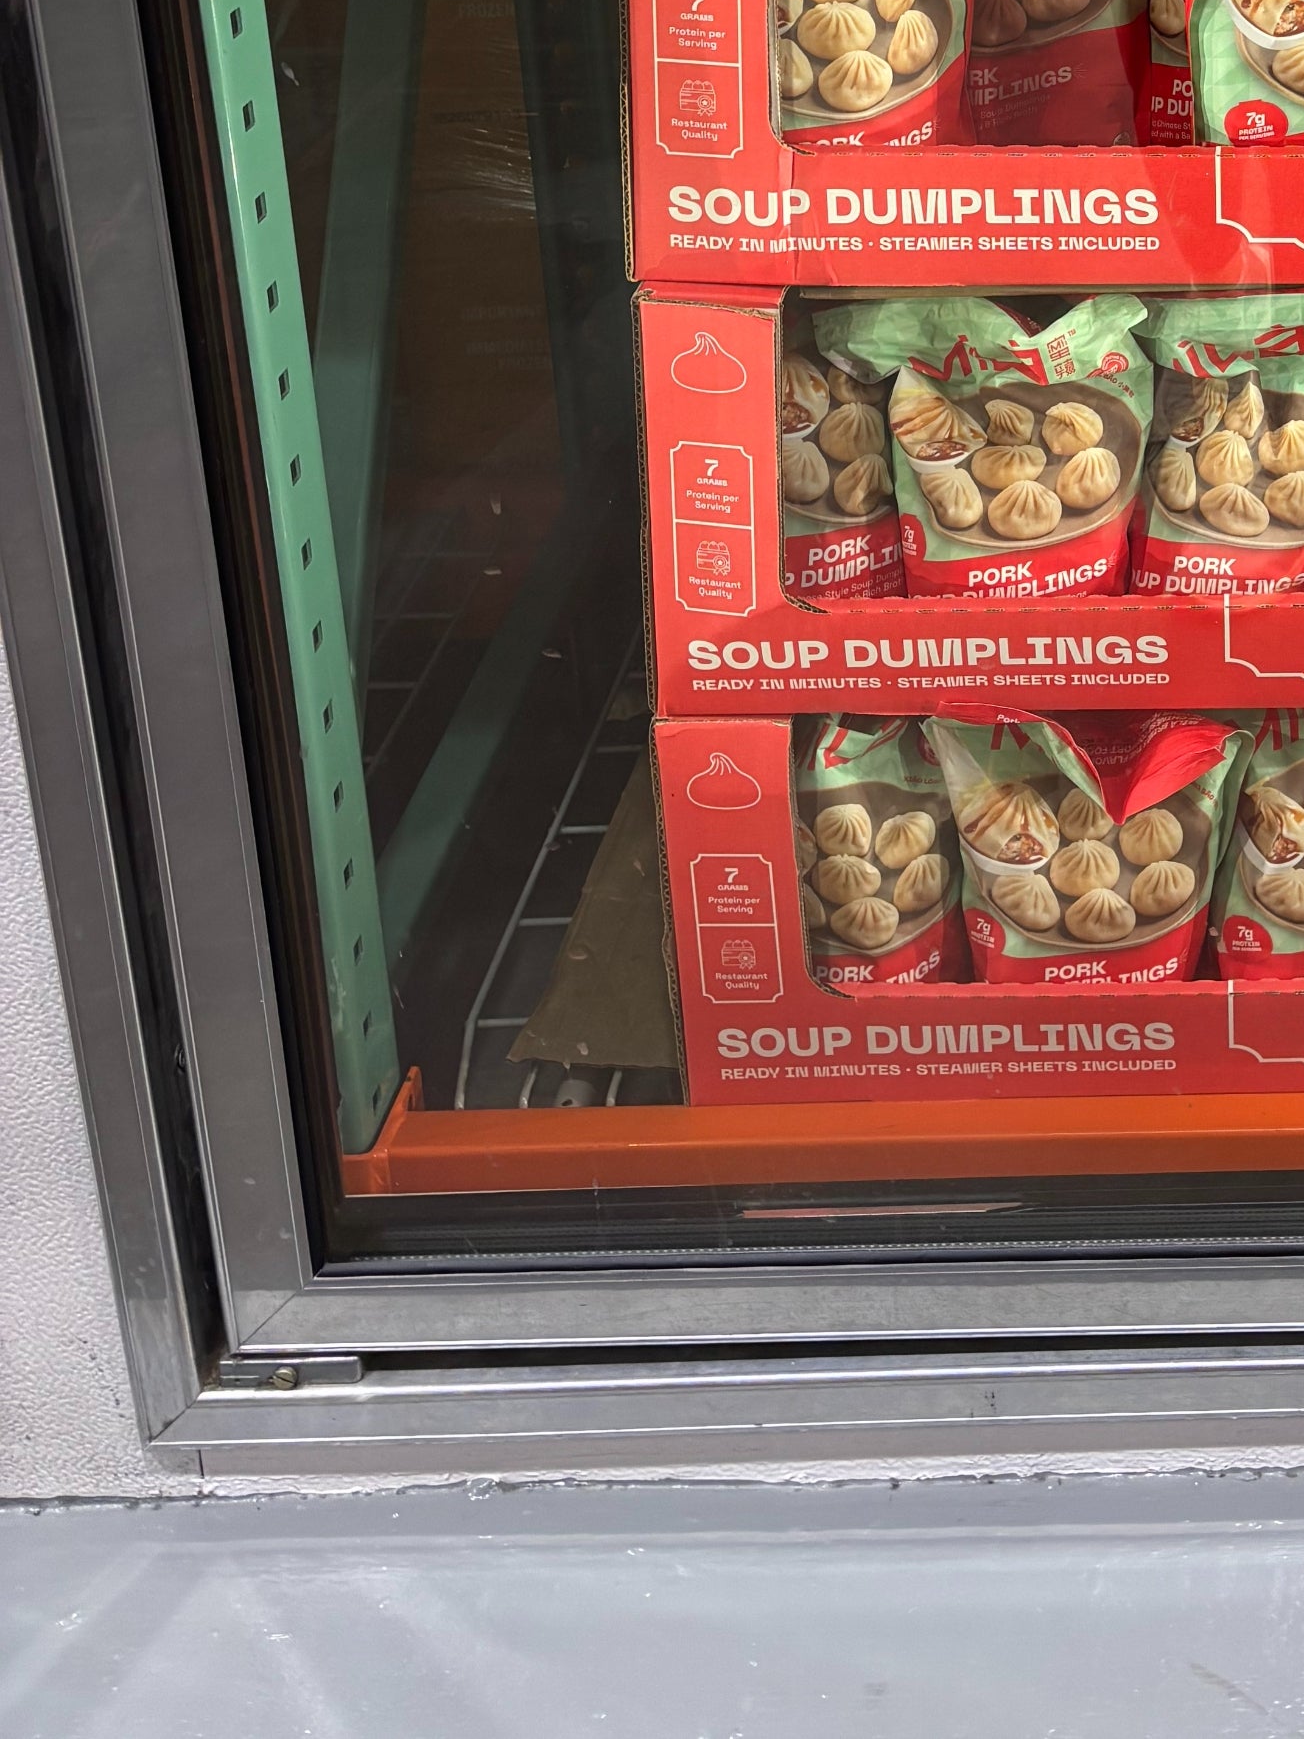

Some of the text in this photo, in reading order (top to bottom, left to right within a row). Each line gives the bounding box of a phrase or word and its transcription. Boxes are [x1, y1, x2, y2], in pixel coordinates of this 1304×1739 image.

[680, 13, 713, 21] GRAMS
[669, 27, 725, 39] Protein per
[678, 38, 717, 50] Serving
[672, 119, 727, 129] Restaurant
[1246, 112, 1265, 126] 7g
[681, 130, 718, 141] Quality
[1239, 124, 1273, 135] PROTEIN
[668, 185, 1159, 227] SOUP DUMPLINGS
[670, 233, 1160, 253] READY IN MINUTES STEAMER SHEETS INCLUDED
[968, 561, 1033, 588] PORK
[1173, 556, 1235, 575] PORK
[688, 635, 1169, 670] SOUP DUMPLINGS
[692, 673, 1170, 691] READY IN MINUTES STEAMER SHEETS INCLUDED
[1044, 960, 1106, 982] PORK
[717, 1023, 1175, 1059] SOUP DUMPLINGS
